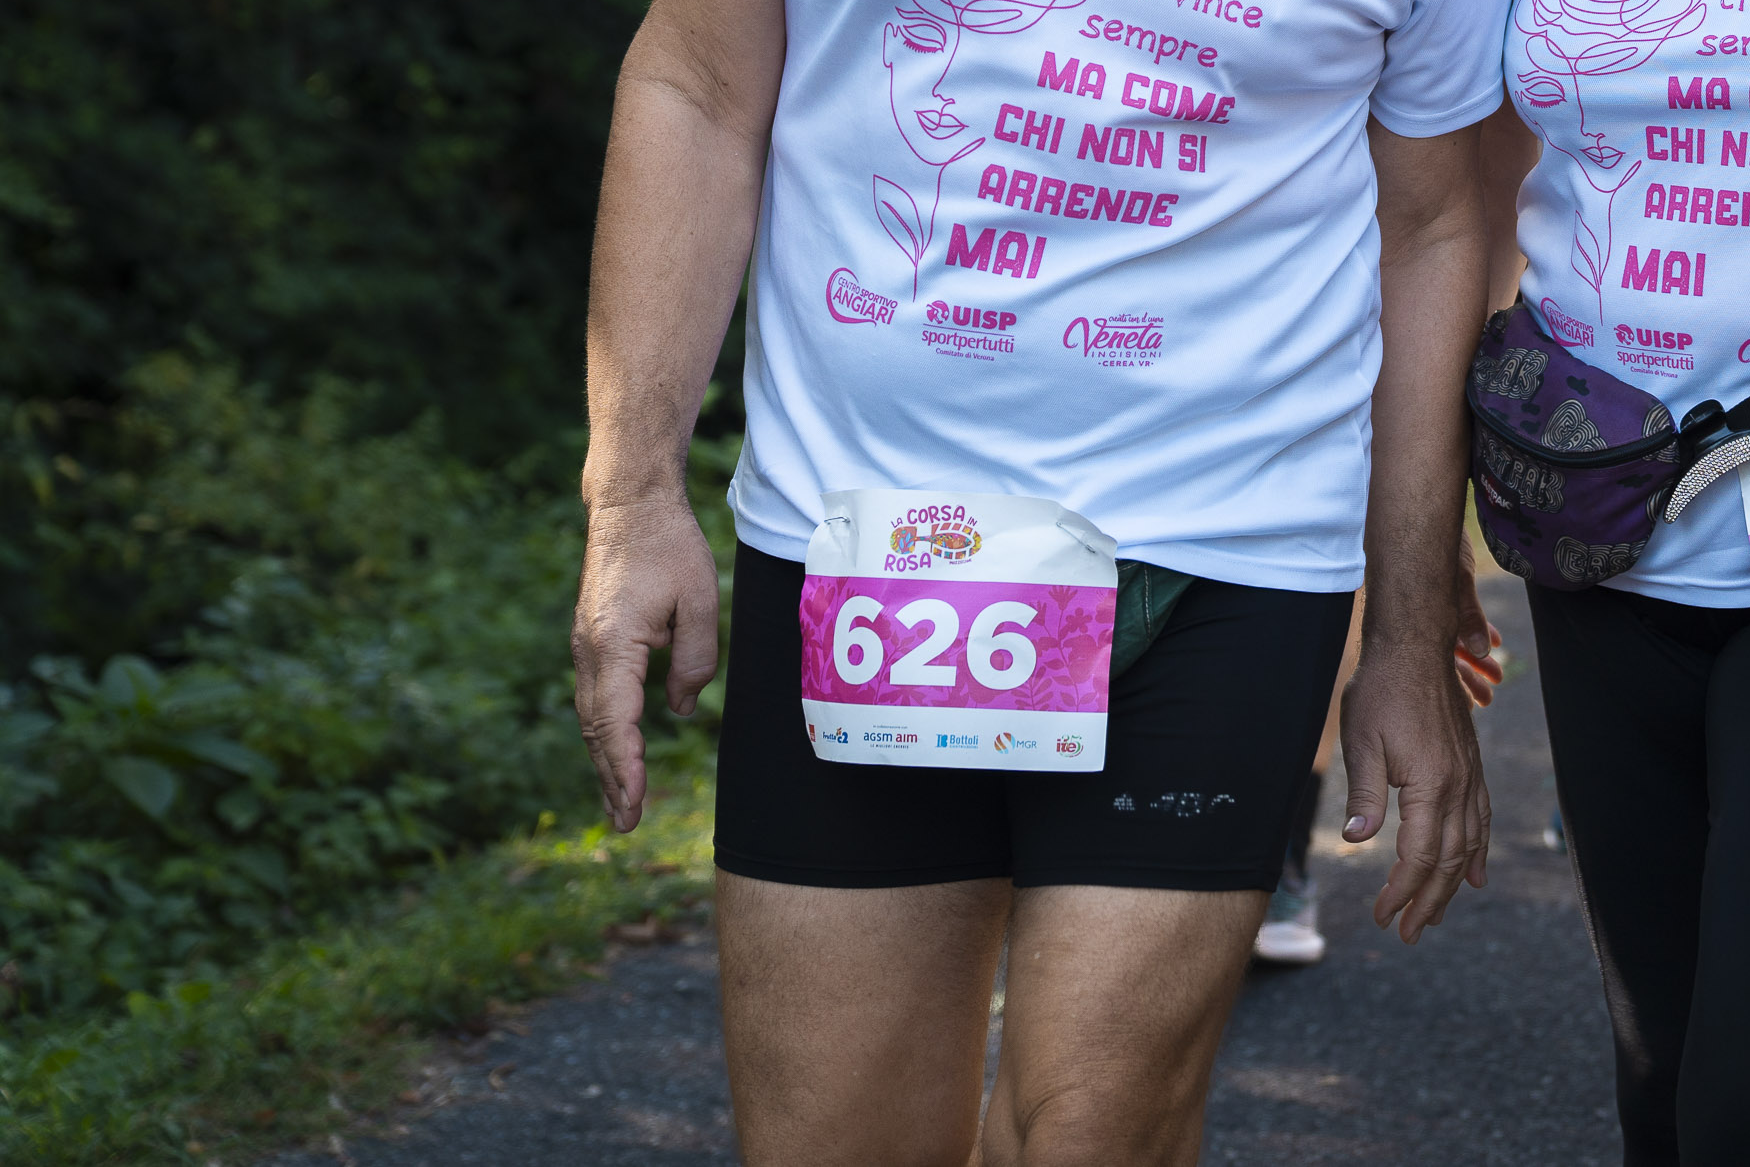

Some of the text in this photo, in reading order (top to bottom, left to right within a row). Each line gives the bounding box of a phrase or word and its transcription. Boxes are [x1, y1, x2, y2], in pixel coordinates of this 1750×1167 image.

[1079, 13, 1218, 68] sempre
[1037, 50, 1236, 125] MA COME
[1667, 76, 1731, 110] MA
[993, 103, 1207, 173] CHI NON SI
[1645, 126, 1705, 165] CHI
[978, 163, 1179, 227] ARRENDE
[945, 223, 1047, 279] MAI
[1621, 246, 1706, 297] MAI
[833, 287, 896, 325] ANGIARI
[838, 276, 898, 309] CENTRO SPORTIVO
[952, 305, 1017, 331] UISP
[1547, 306, 1593, 332] CENTRO SPORTIVO
[1550, 315, 1594, 347] ANGIARI
[921, 329, 1015, 353] sportpertutti
[1063, 317, 1163, 358] Veneta
[1636, 328, 1693, 350] UISP
[935, 348, 964, 358] Comitato
[973, 353, 995, 361] Verona
[1617, 351, 1694, 370] sportpertutti
[1481, 473, 1513, 510] EASTPAK
[891, 505, 977, 528] LA CORSA IN
[884, 552, 931, 572] ROSA
[833, 595, 1038, 690] 626
[896, 734, 917, 743] aim
[950, 734, 978, 745] Bottoli
[1017, 740, 1037, 748] MGR
